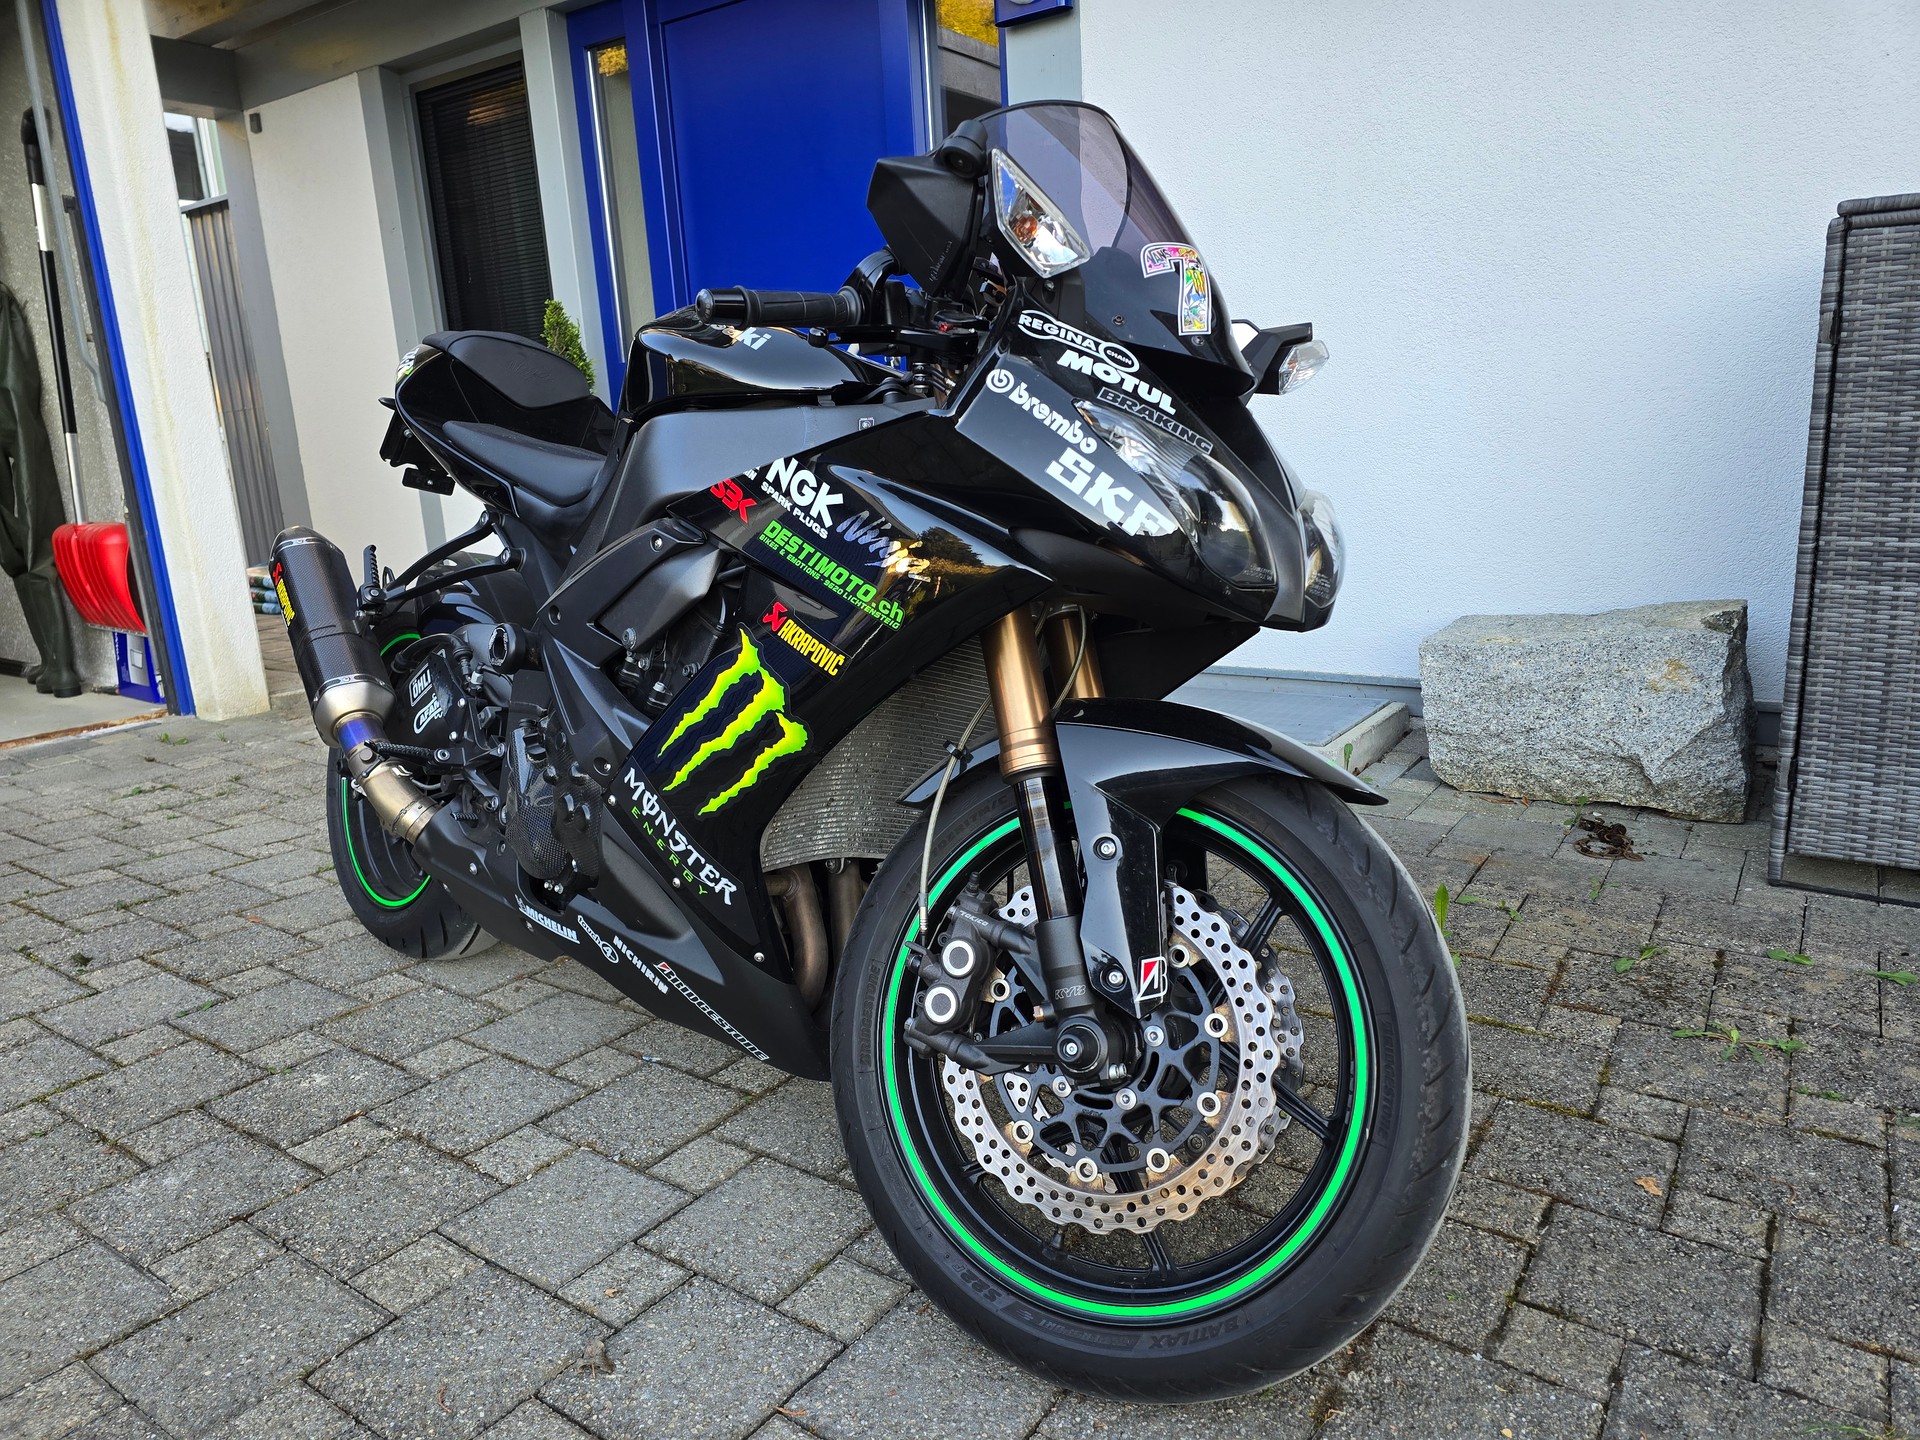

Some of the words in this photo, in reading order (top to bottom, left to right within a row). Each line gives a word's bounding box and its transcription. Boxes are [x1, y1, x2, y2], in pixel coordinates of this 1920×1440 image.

[1019, 314, 1098, 351] REGINA
[1106, 349, 1133, 366] CHAIN
[1056, 349, 1177, 415] MOTUL
[1008, 382, 1098, 454] brembo
[1096, 387, 1214, 454] BRAKING
[760, 481, 794, 512] SPARK
[792, 507, 829, 540] PLUGS
[765, 456, 844, 528] NGK
[759, 533, 780, 551] BIKES
[779, 549, 786, 557] &
[786, 553, 821, 580] EMOTIONS
[823, 579, 844, 595] 9620
[842, 592, 901, 629] LICHTENSTEIG
[763, 520, 904, 623] DESTIMOTO.ch
[631, 806, 708, 895] ENERGY
[525, 904, 578, 941] MICHELIN
[959, 910, 989, 927] TOKICO
[612, 935, 670, 995] NICHIRIN
[1054, 984, 1087, 1000] KYB
[653, 961, 770, 1061] BRIDGESTONE
